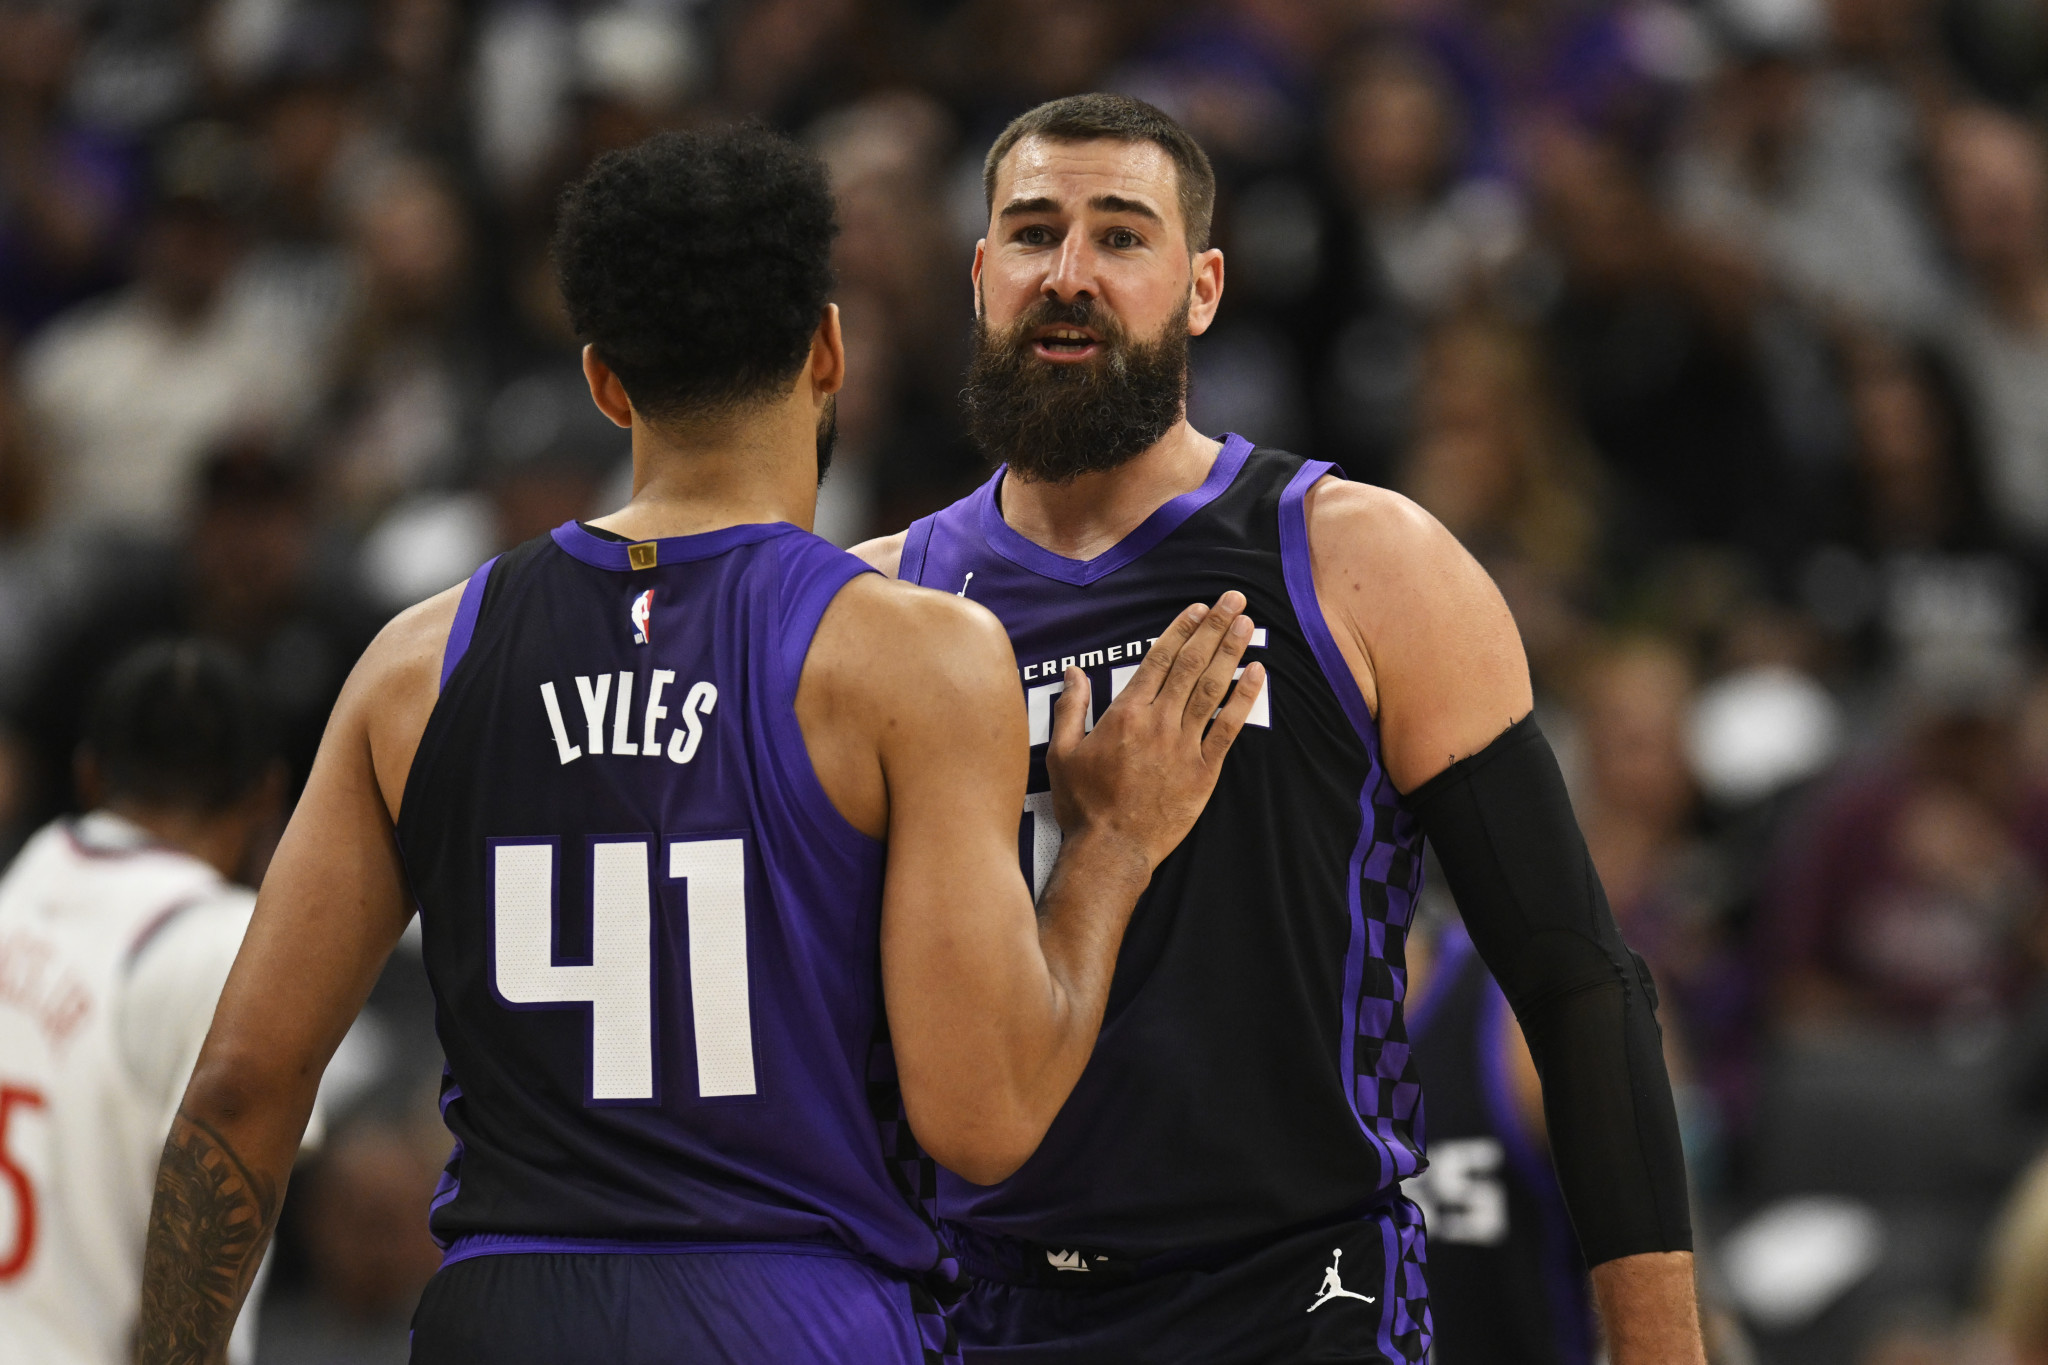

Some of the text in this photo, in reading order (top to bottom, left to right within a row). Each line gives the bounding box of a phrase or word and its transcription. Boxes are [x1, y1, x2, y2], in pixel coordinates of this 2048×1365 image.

[1018, 636, 1159, 682] CRAMENT
[540, 669, 718, 765] LYLES
[494, 838, 757, 1099] 41
